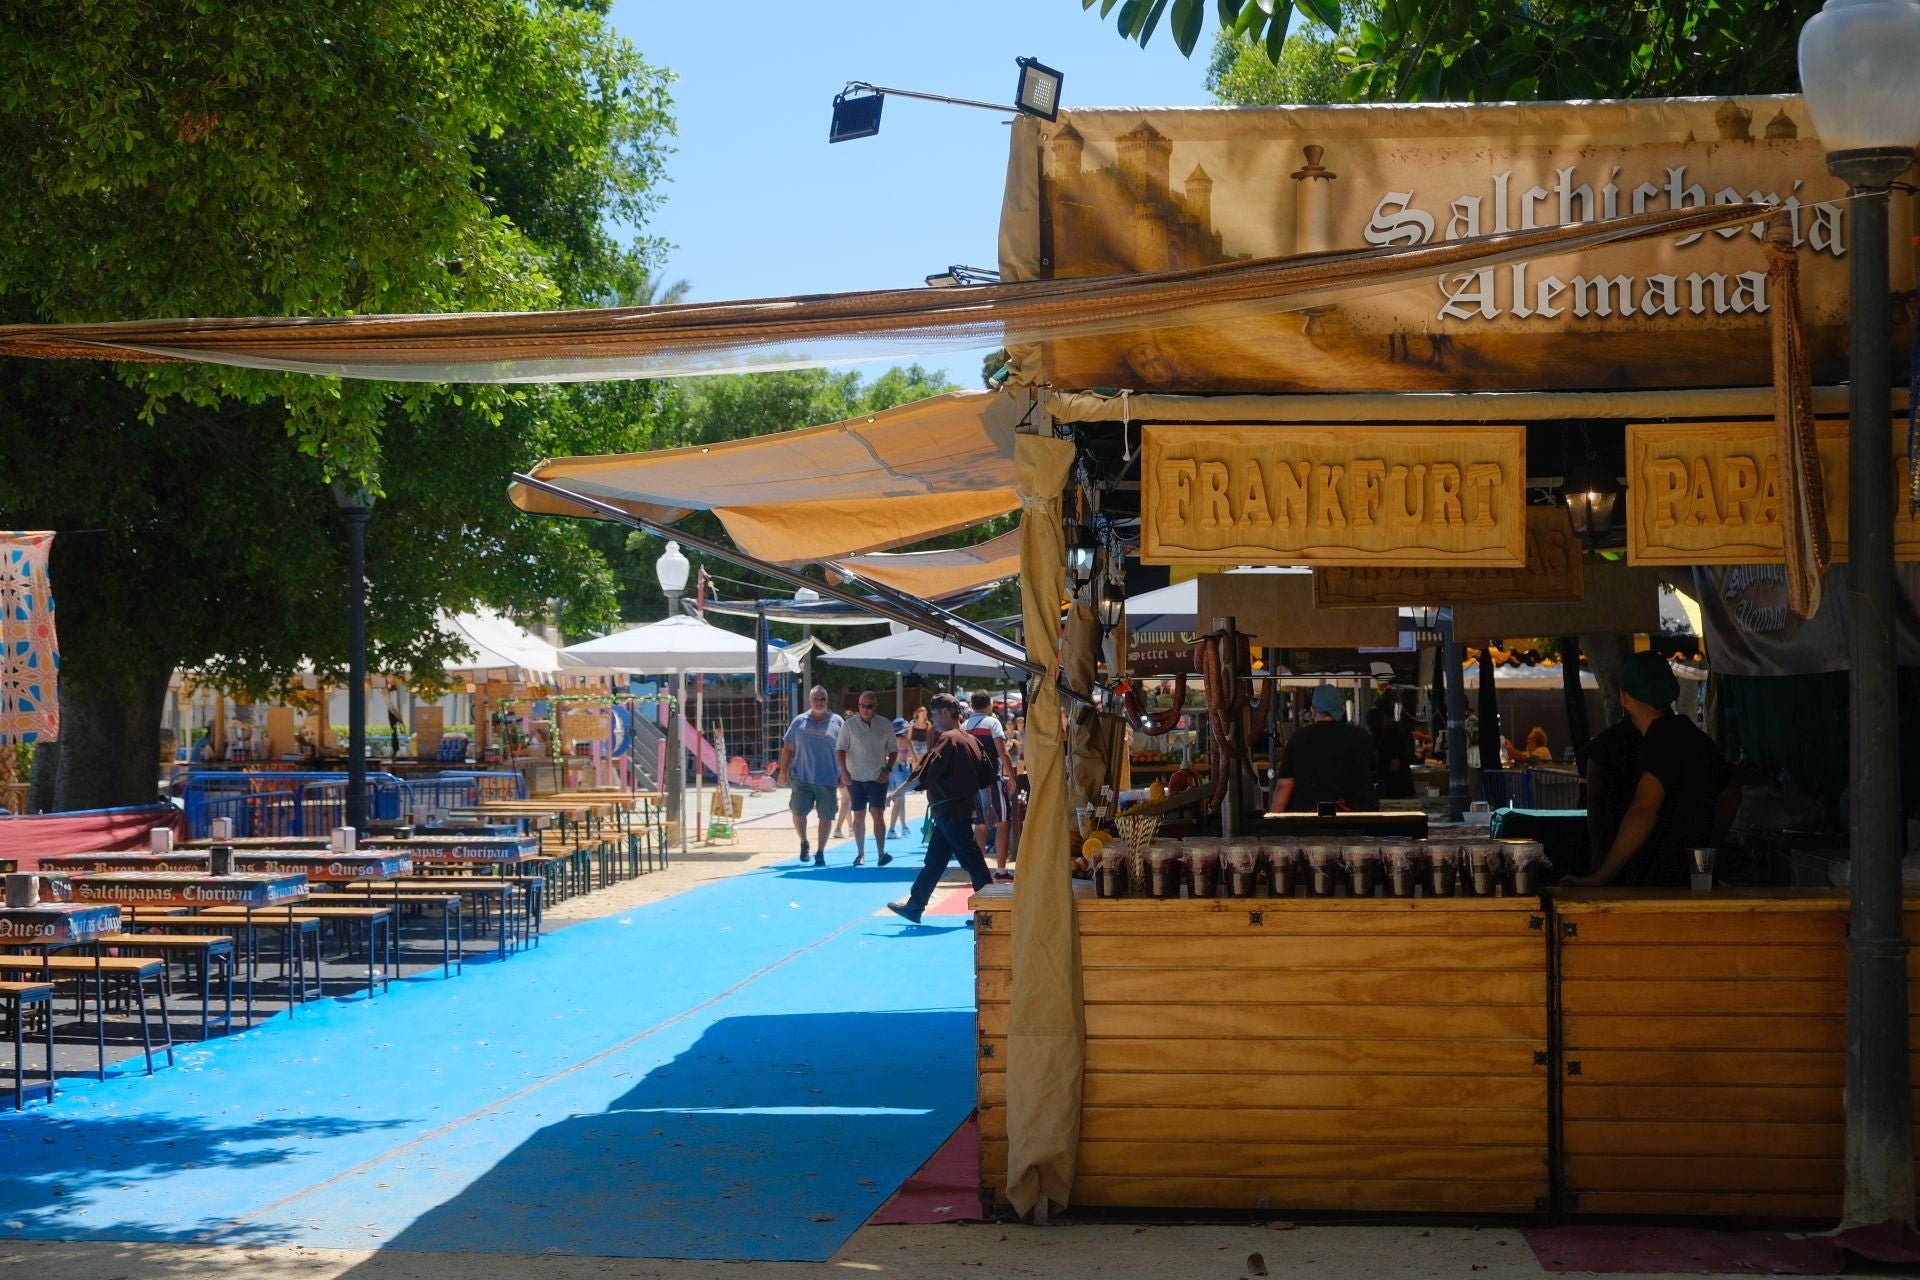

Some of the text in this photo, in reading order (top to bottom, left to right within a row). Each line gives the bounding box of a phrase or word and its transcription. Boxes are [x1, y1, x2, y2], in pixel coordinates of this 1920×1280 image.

[1437, 262, 1770, 321] Alemana
[1163, 458, 1501, 530] FRANKFURT
[452, 846, 509, 859] Choripan
[264, 861, 308, 875] Bacon
[314, 865, 323, 877] y
[328, 861, 374, 876] Queso
[182, 884, 254, 903] Choripan
[0, 918, 56, 937] Queso
